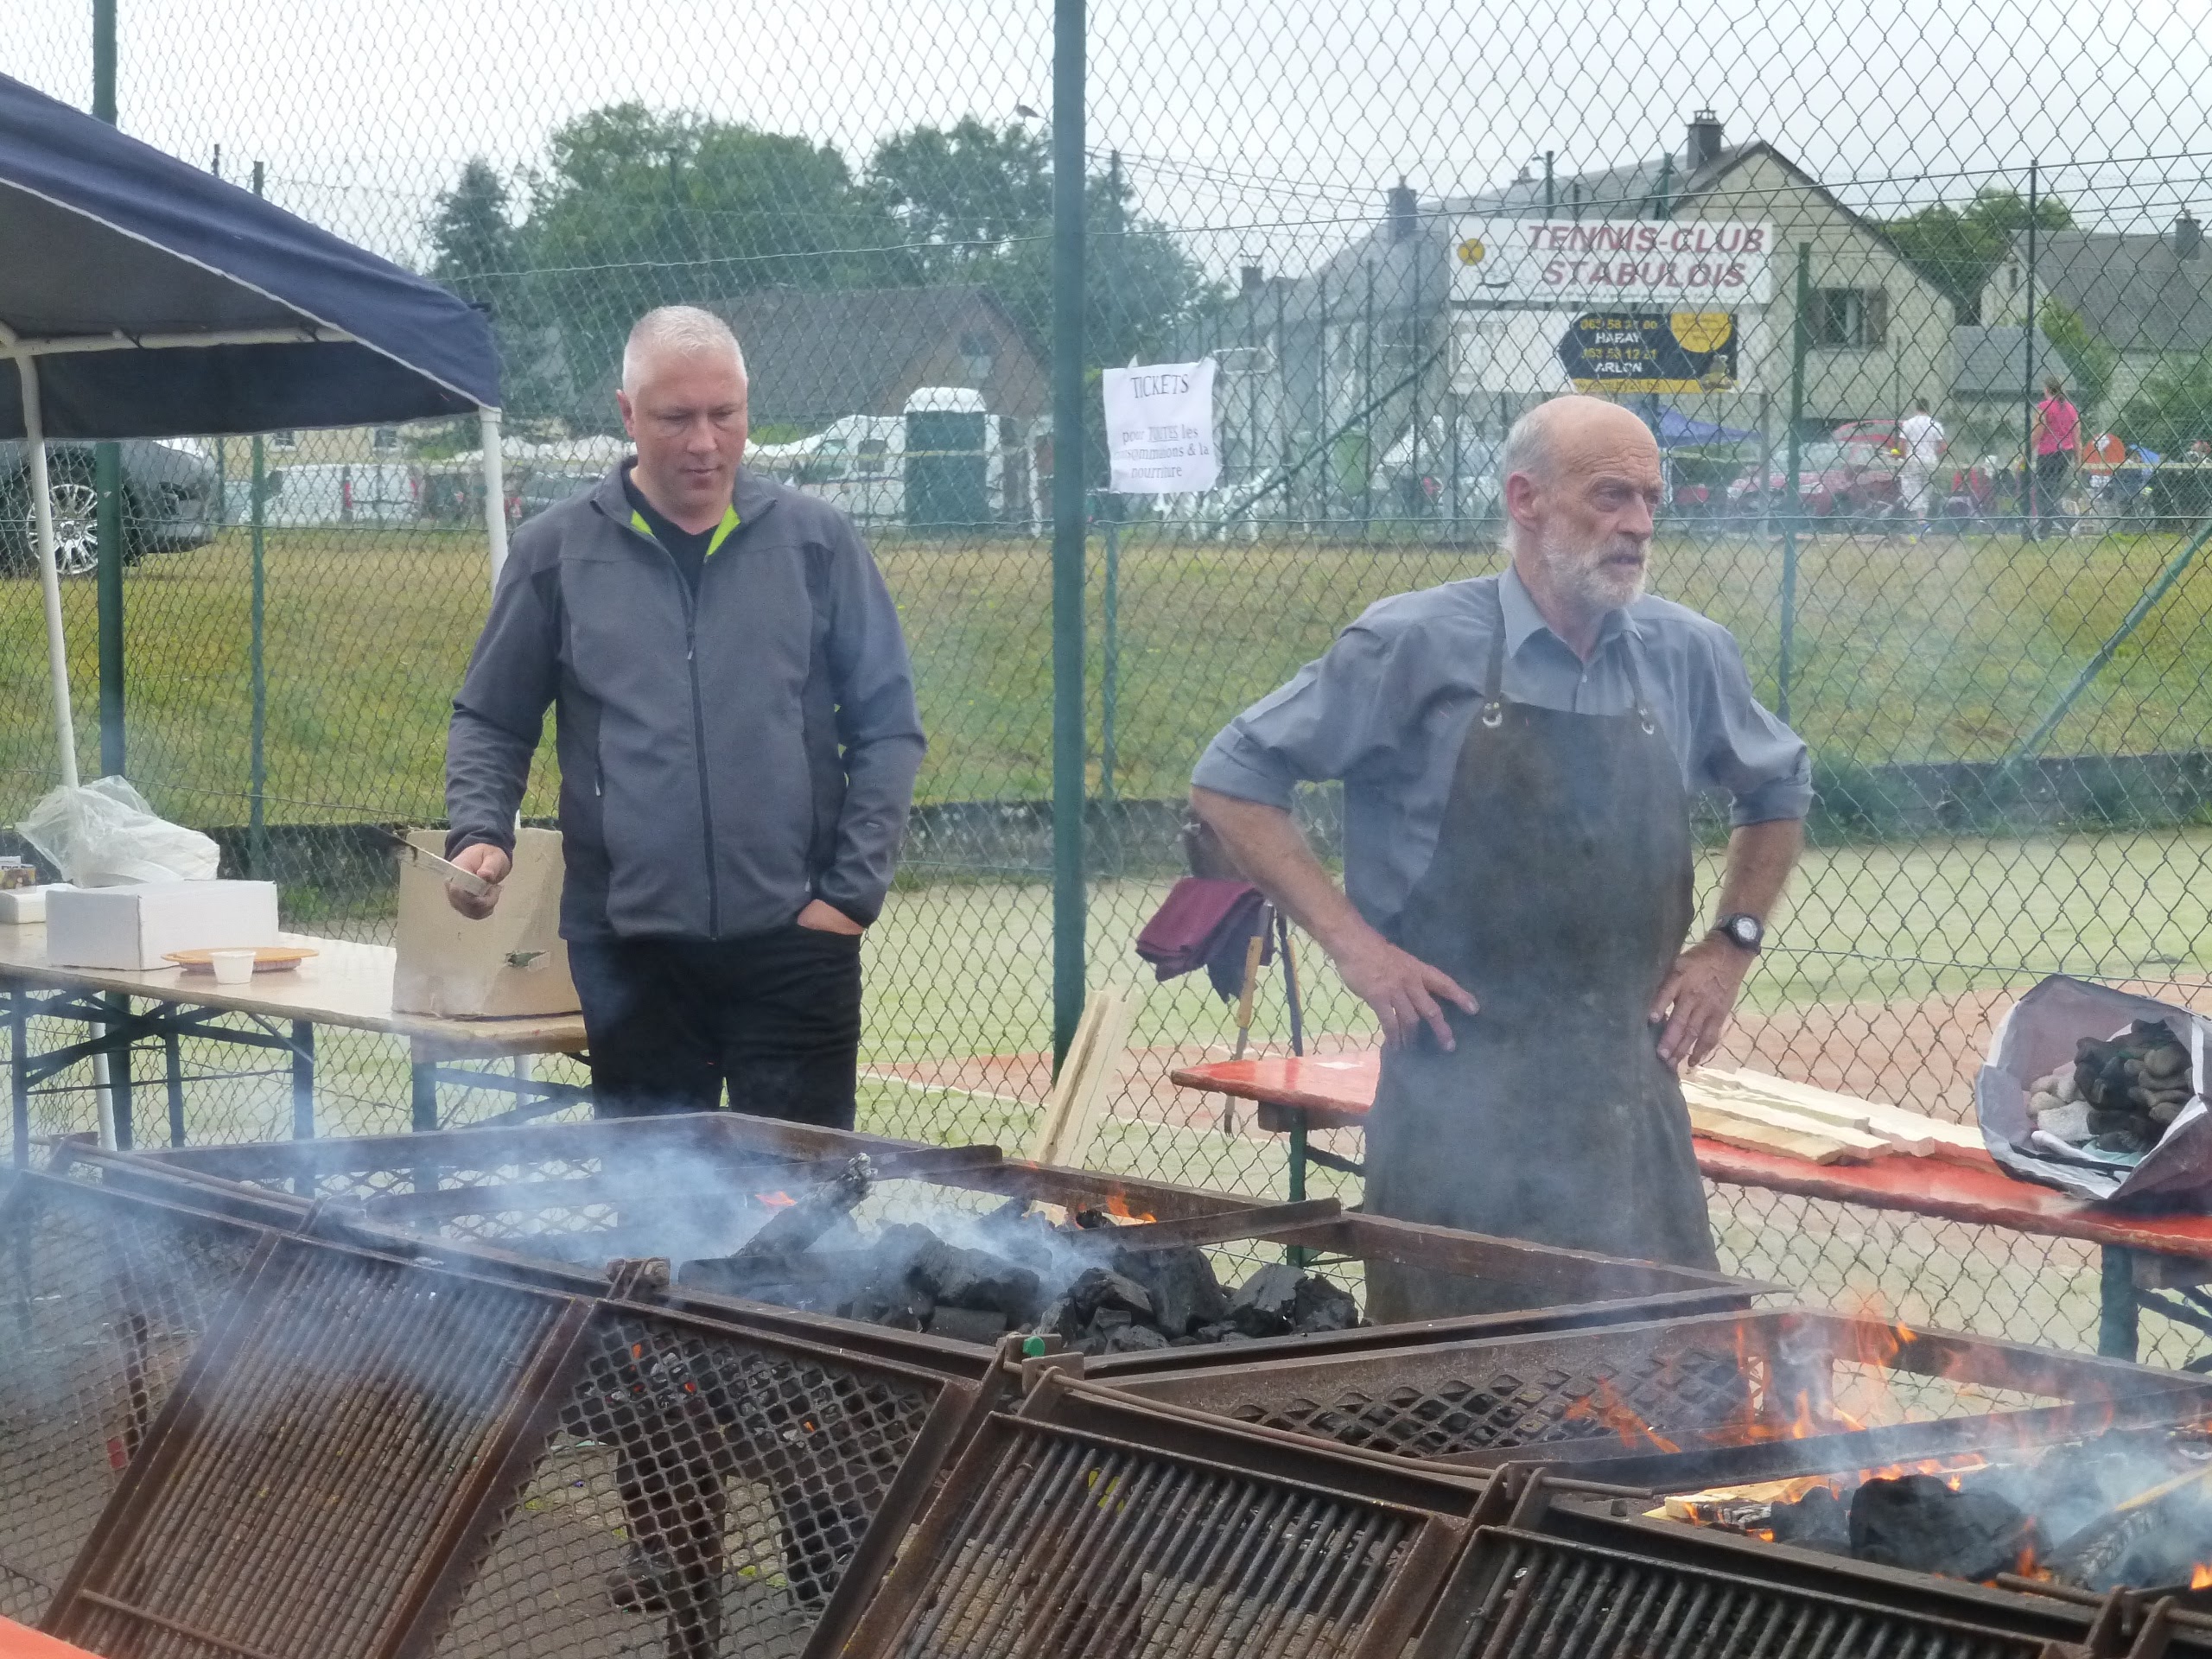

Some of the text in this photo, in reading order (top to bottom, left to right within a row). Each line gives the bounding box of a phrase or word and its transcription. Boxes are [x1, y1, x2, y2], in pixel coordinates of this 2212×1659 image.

[1528, 225, 1764, 253] TENNIS-CLUB
[1543, 259, 1746, 288] STABULOIS
[1595, 362, 1643, 373] ARLON
[1131, 374, 1189, 398] TICKETS
[1122, 430, 1145, 445] pour
[1182, 424, 1199, 439] les
[1186, 443, 1197, 456] &
[1200, 442, 1210, 455] la
